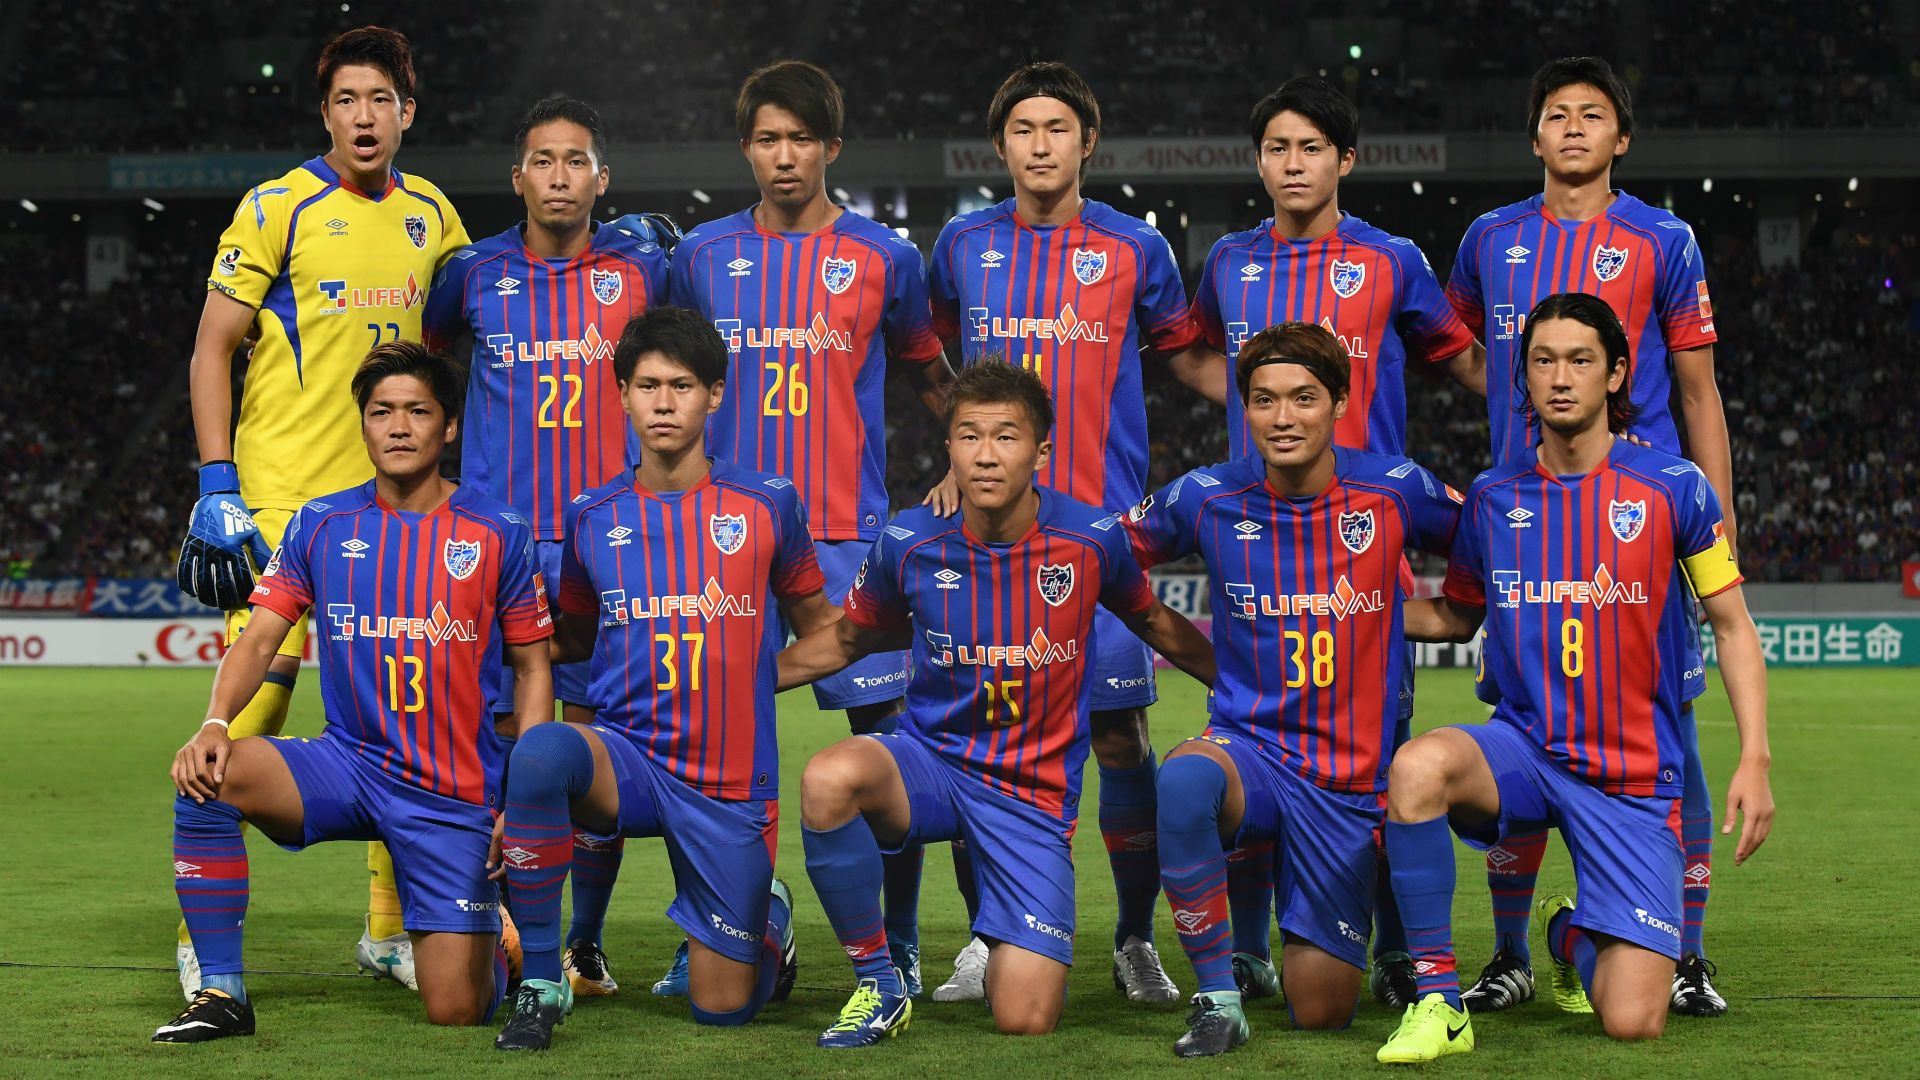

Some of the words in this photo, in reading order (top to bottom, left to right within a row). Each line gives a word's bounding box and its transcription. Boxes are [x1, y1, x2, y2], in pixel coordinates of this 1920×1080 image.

[498, 288, 519, 296] umbro
[763, 362, 808, 416] 26
[538, 374, 583, 428] 22
[1509, 521, 1532, 529] umbro
[608, 538, 632, 547] umbro
[1236, 533, 1261, 541] umbro
[341, 551, 366, 559] umbro
[936, 582, 960, 590] umbro
[1561, 618, 1584, 678] 8
[655, 632, 704, 691] 37
[1284, 630, 1334, 688] 38
[384, 655, 425, 713] 13
[866, 674, 893, 687] TOKYO
[1120, 678, 1145, 689] TOKYO
[983, 679, 1022, 726] 15
[722, 923, 749, 941] TOKYO
[1036, 921, 1063, 939] TOKYO
[1648, 916, 1673, 934] TOKYO
